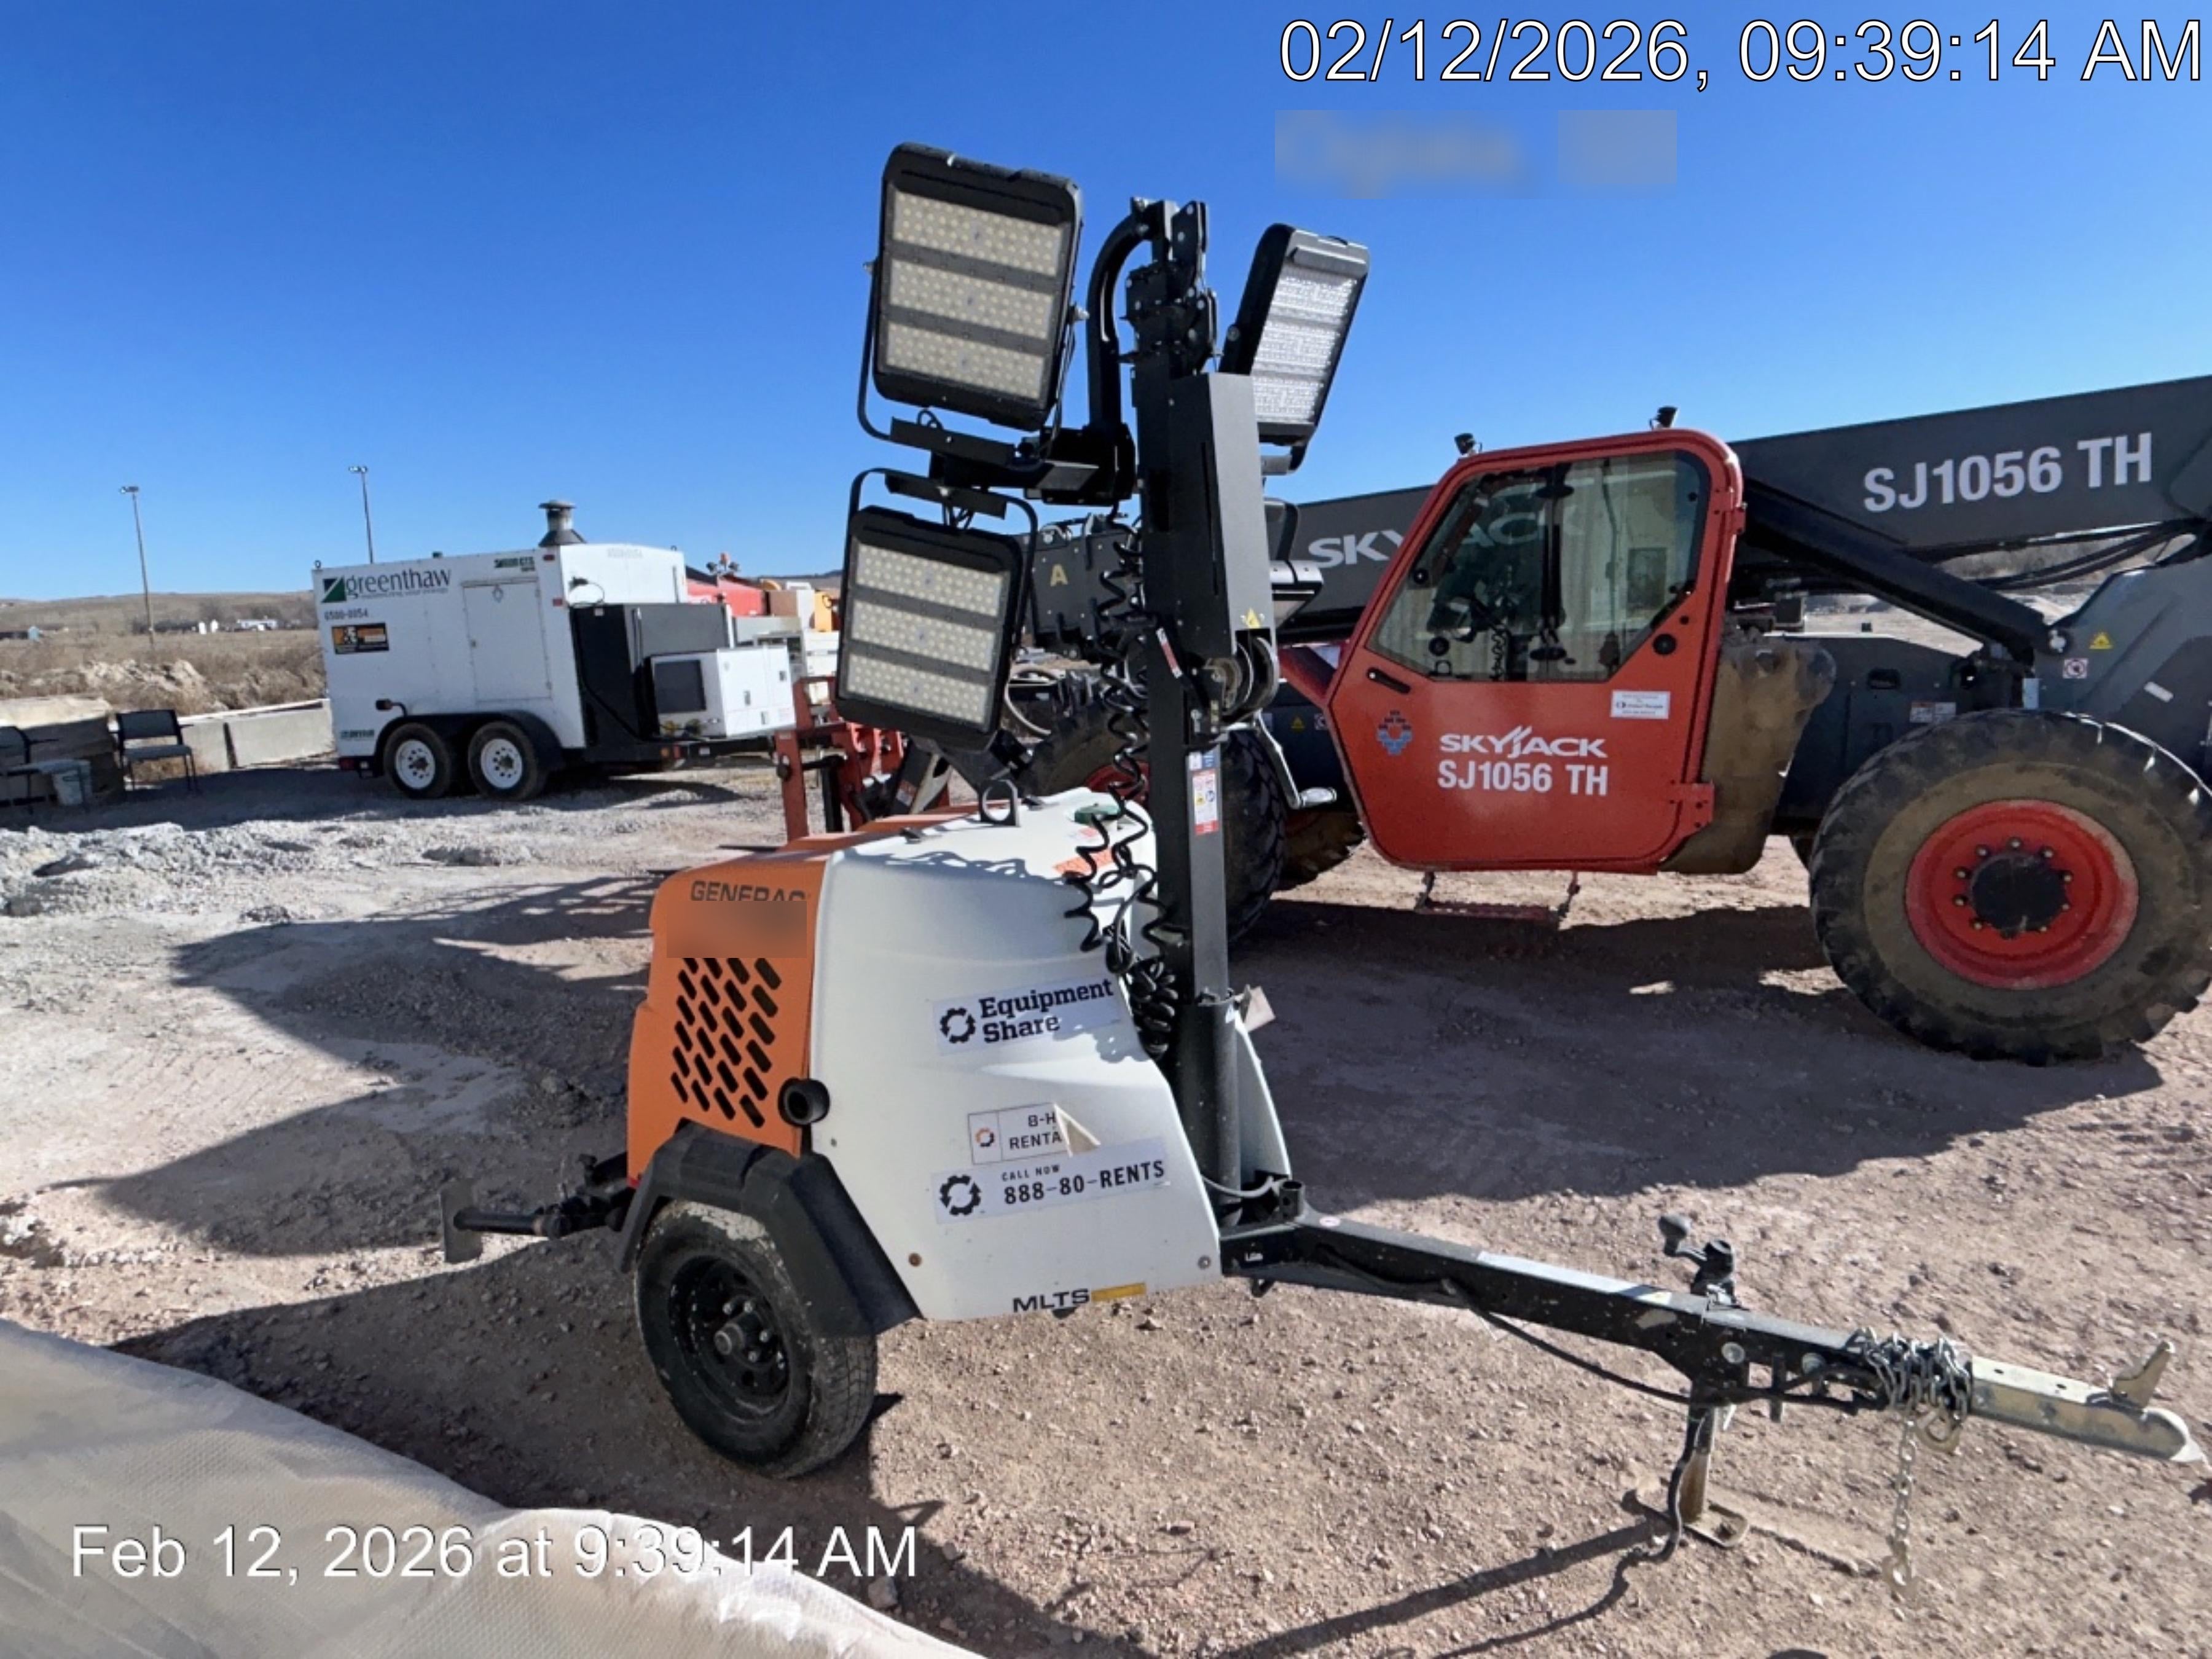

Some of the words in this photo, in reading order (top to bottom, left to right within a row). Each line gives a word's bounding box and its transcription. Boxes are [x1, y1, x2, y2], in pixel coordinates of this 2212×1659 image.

[1864, 446, 2063, 512] SJ1056
[2077, 431, 2152, 488] TH
[347, 568, 452, 600] greenthaw
[1050, 563, 1068, 587] A
[1439, 726, 1608, 759] SKYJACK
[1437, 759, 1553, 793] SJ1056
[1565, 764, 1609, 796] TH
[979, 978, 1114, 1019] Equipment
[982, 1015, 1061, 1043] Share
[1001, 1169, 1030, 1182] CALL
[1035, 1164, 1061, 1177] NOW
[1004, 1159, 1164, 1205] 888-80-RENTS
[1012, 1288, 1091, 1313] MLTS
